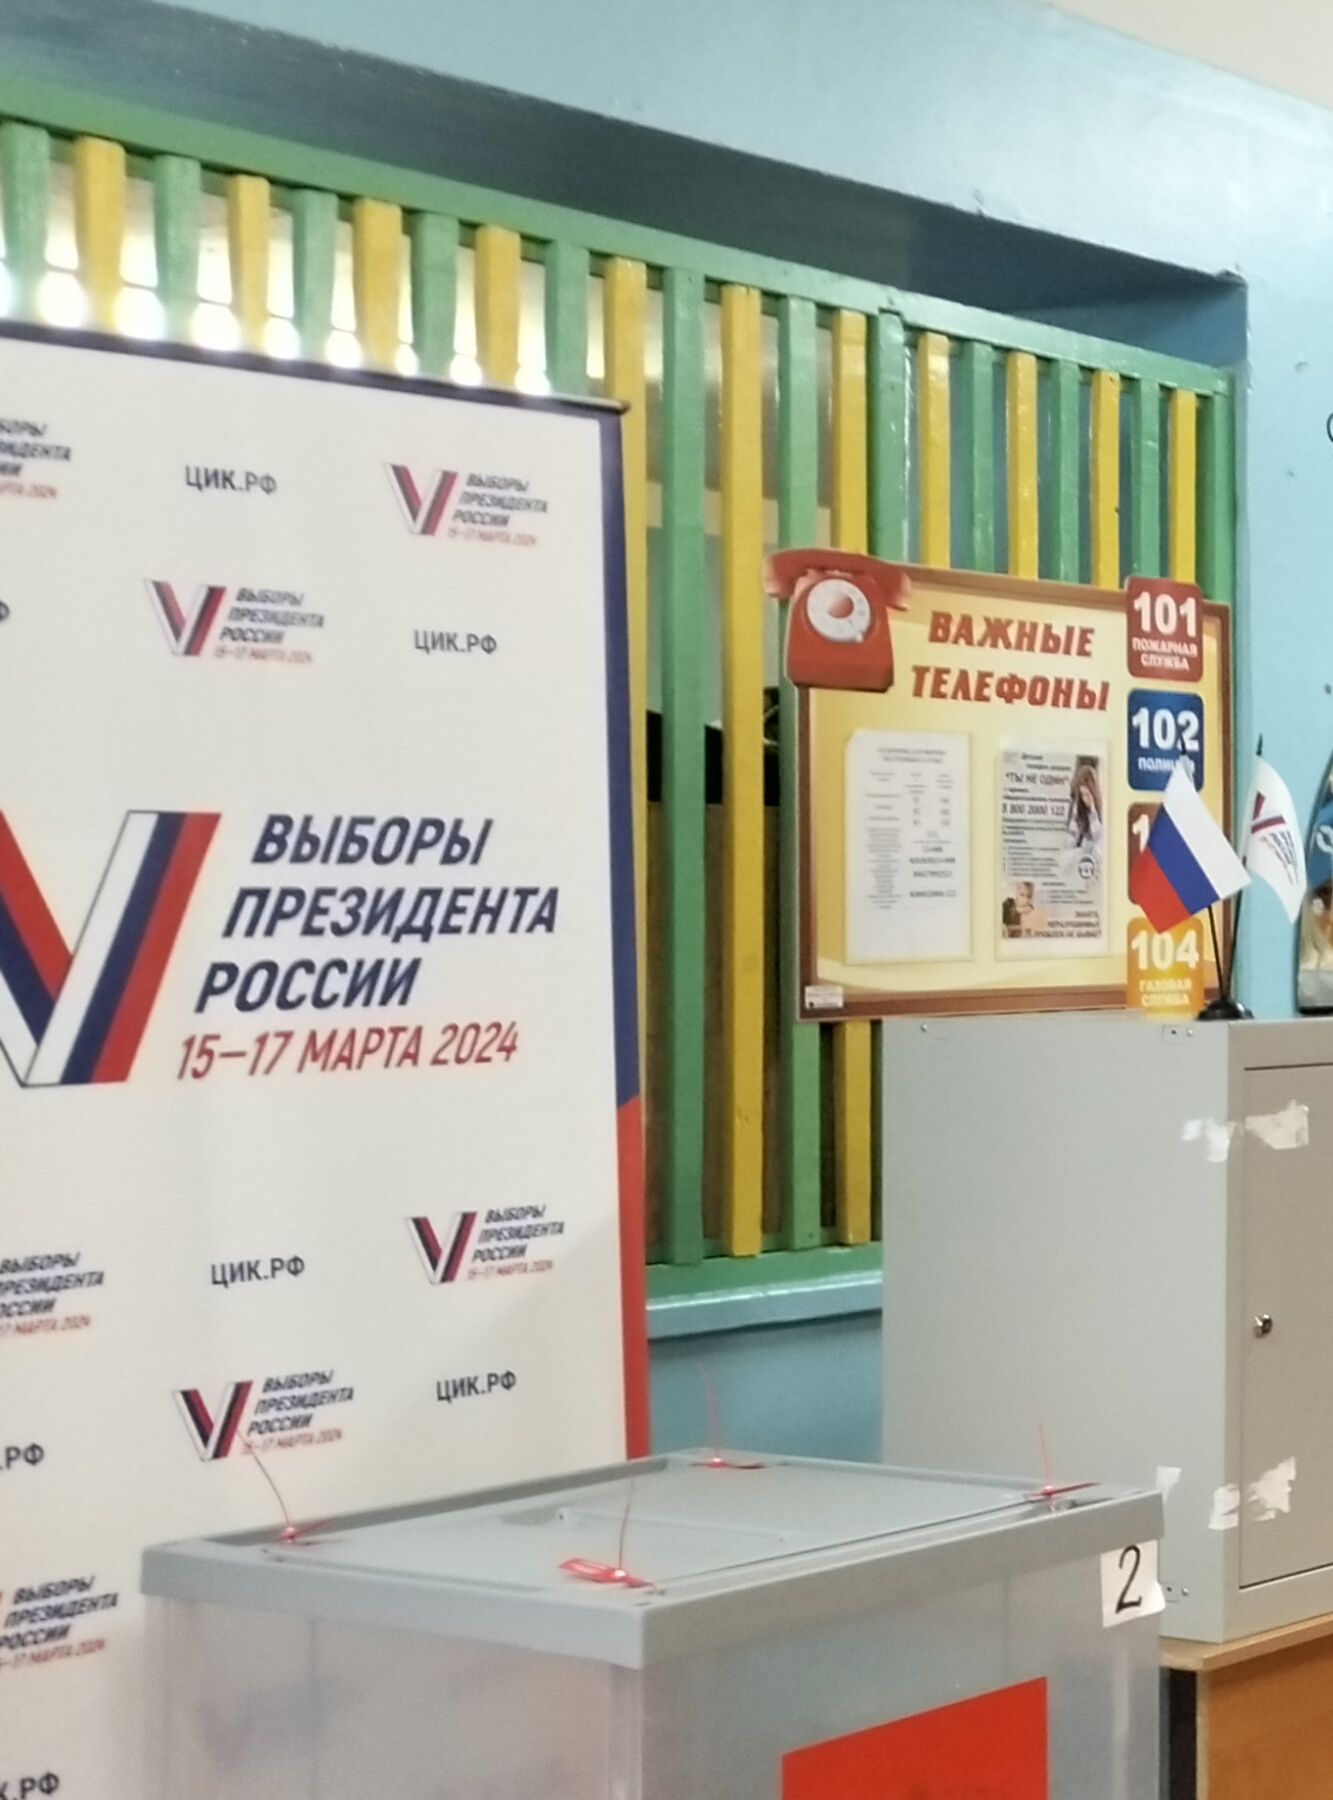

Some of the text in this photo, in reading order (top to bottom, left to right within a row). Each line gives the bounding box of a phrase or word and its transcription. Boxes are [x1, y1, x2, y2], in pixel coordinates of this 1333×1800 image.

[186, 465, 277, 495] ЦИК.РФ
[928, 610, 1095, 657] ВАЖНЫЕ
[1133, 591, 1197, 638] 101
[415, 630, 497, 655] ЦИК.РФ
[1132, 636, 1198, 658] ПОЖАРНАЯ
[1140, 653, 1190, 671] СЛУЖБА
[912, 664, 1110, 711] ТЕЛЕФОНЫ
[1132, 707, 1199, 752] 102
[251, 813, 494, 866] ВЫБОРЫ
[222, 886, 559, 942] ПРЕЗИДЕНТА
[1131, 929, 1199, 970] 104
[194, 957, 422, 1014] РОССИИ
[177, 1020, 518, 1081] 15–17 МАРТА 2024
[211, 1256, 305, 1287] ЦИК.РФ
[255, 1387, 354, 1415] ПРЕЗИДЕНТА
[262, 1370, 334, 1393] ВЫБОРЫ
[436, 1371, 517, 1403] ЦИК.РФ
[247, 1413, 314, 1436] РОССИИ
[1115, 1545, 1142, 1614] 2
